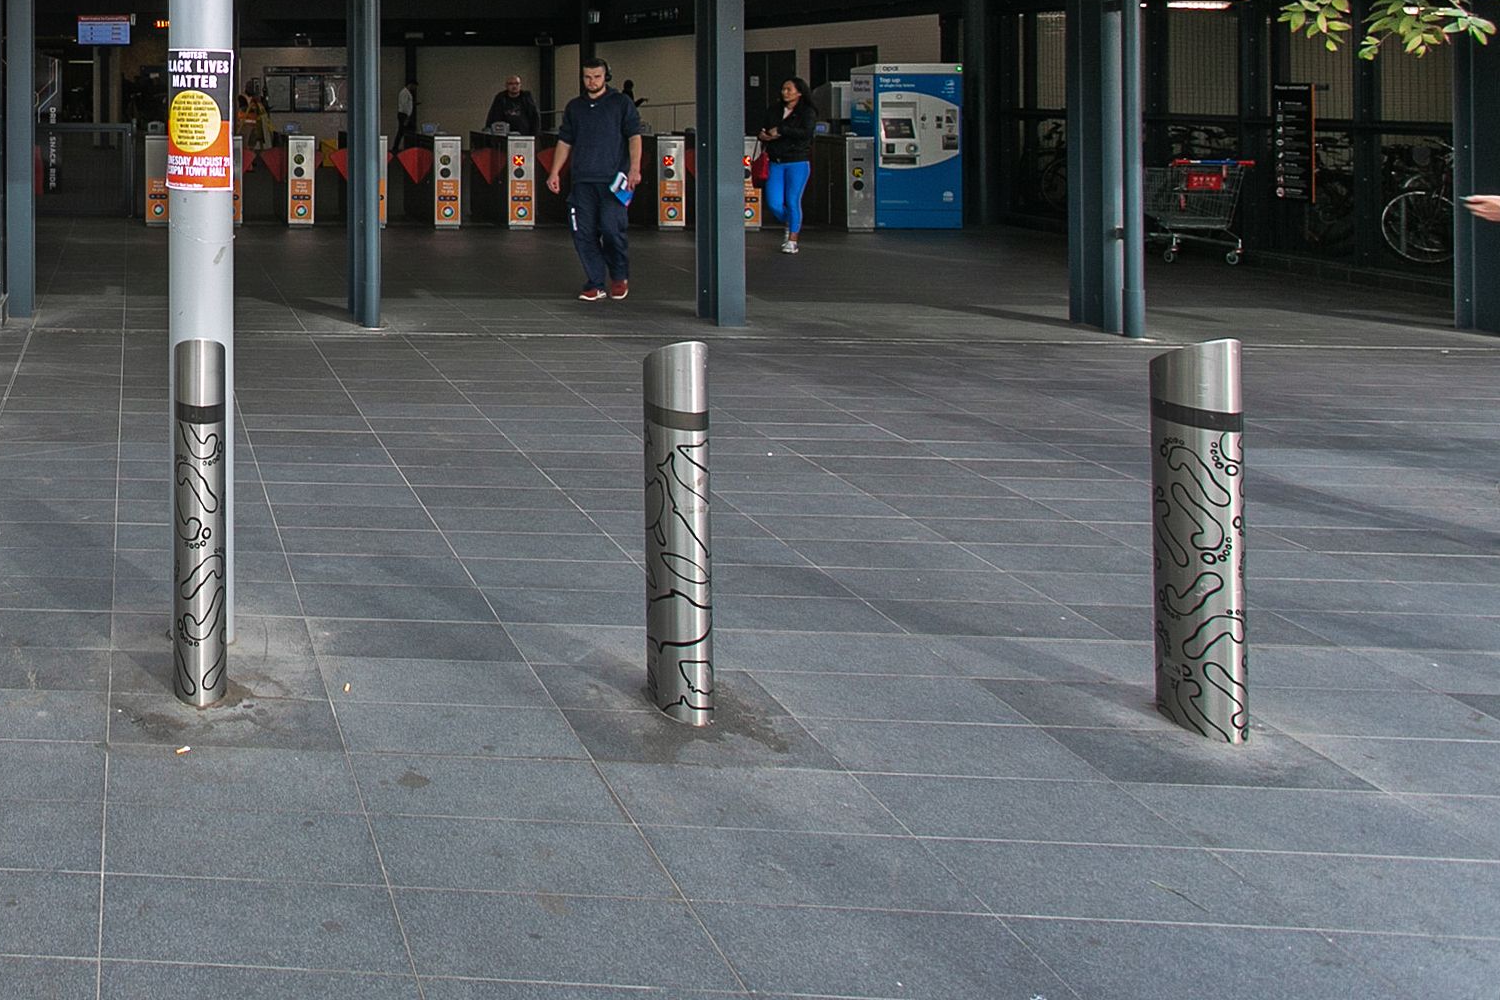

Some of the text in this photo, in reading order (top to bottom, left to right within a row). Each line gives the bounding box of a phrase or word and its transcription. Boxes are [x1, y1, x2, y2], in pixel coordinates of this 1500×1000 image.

[178, 51, 208, 60] PROTEST:
[168, 60, 229, 75] LACK LIVES
[172, 75, 218, 89] MATTER
[194, 156, 223, 168] AUGUST
[185, 166, 207, 177] TOWN
[209, 167, 226, 177] HALL
